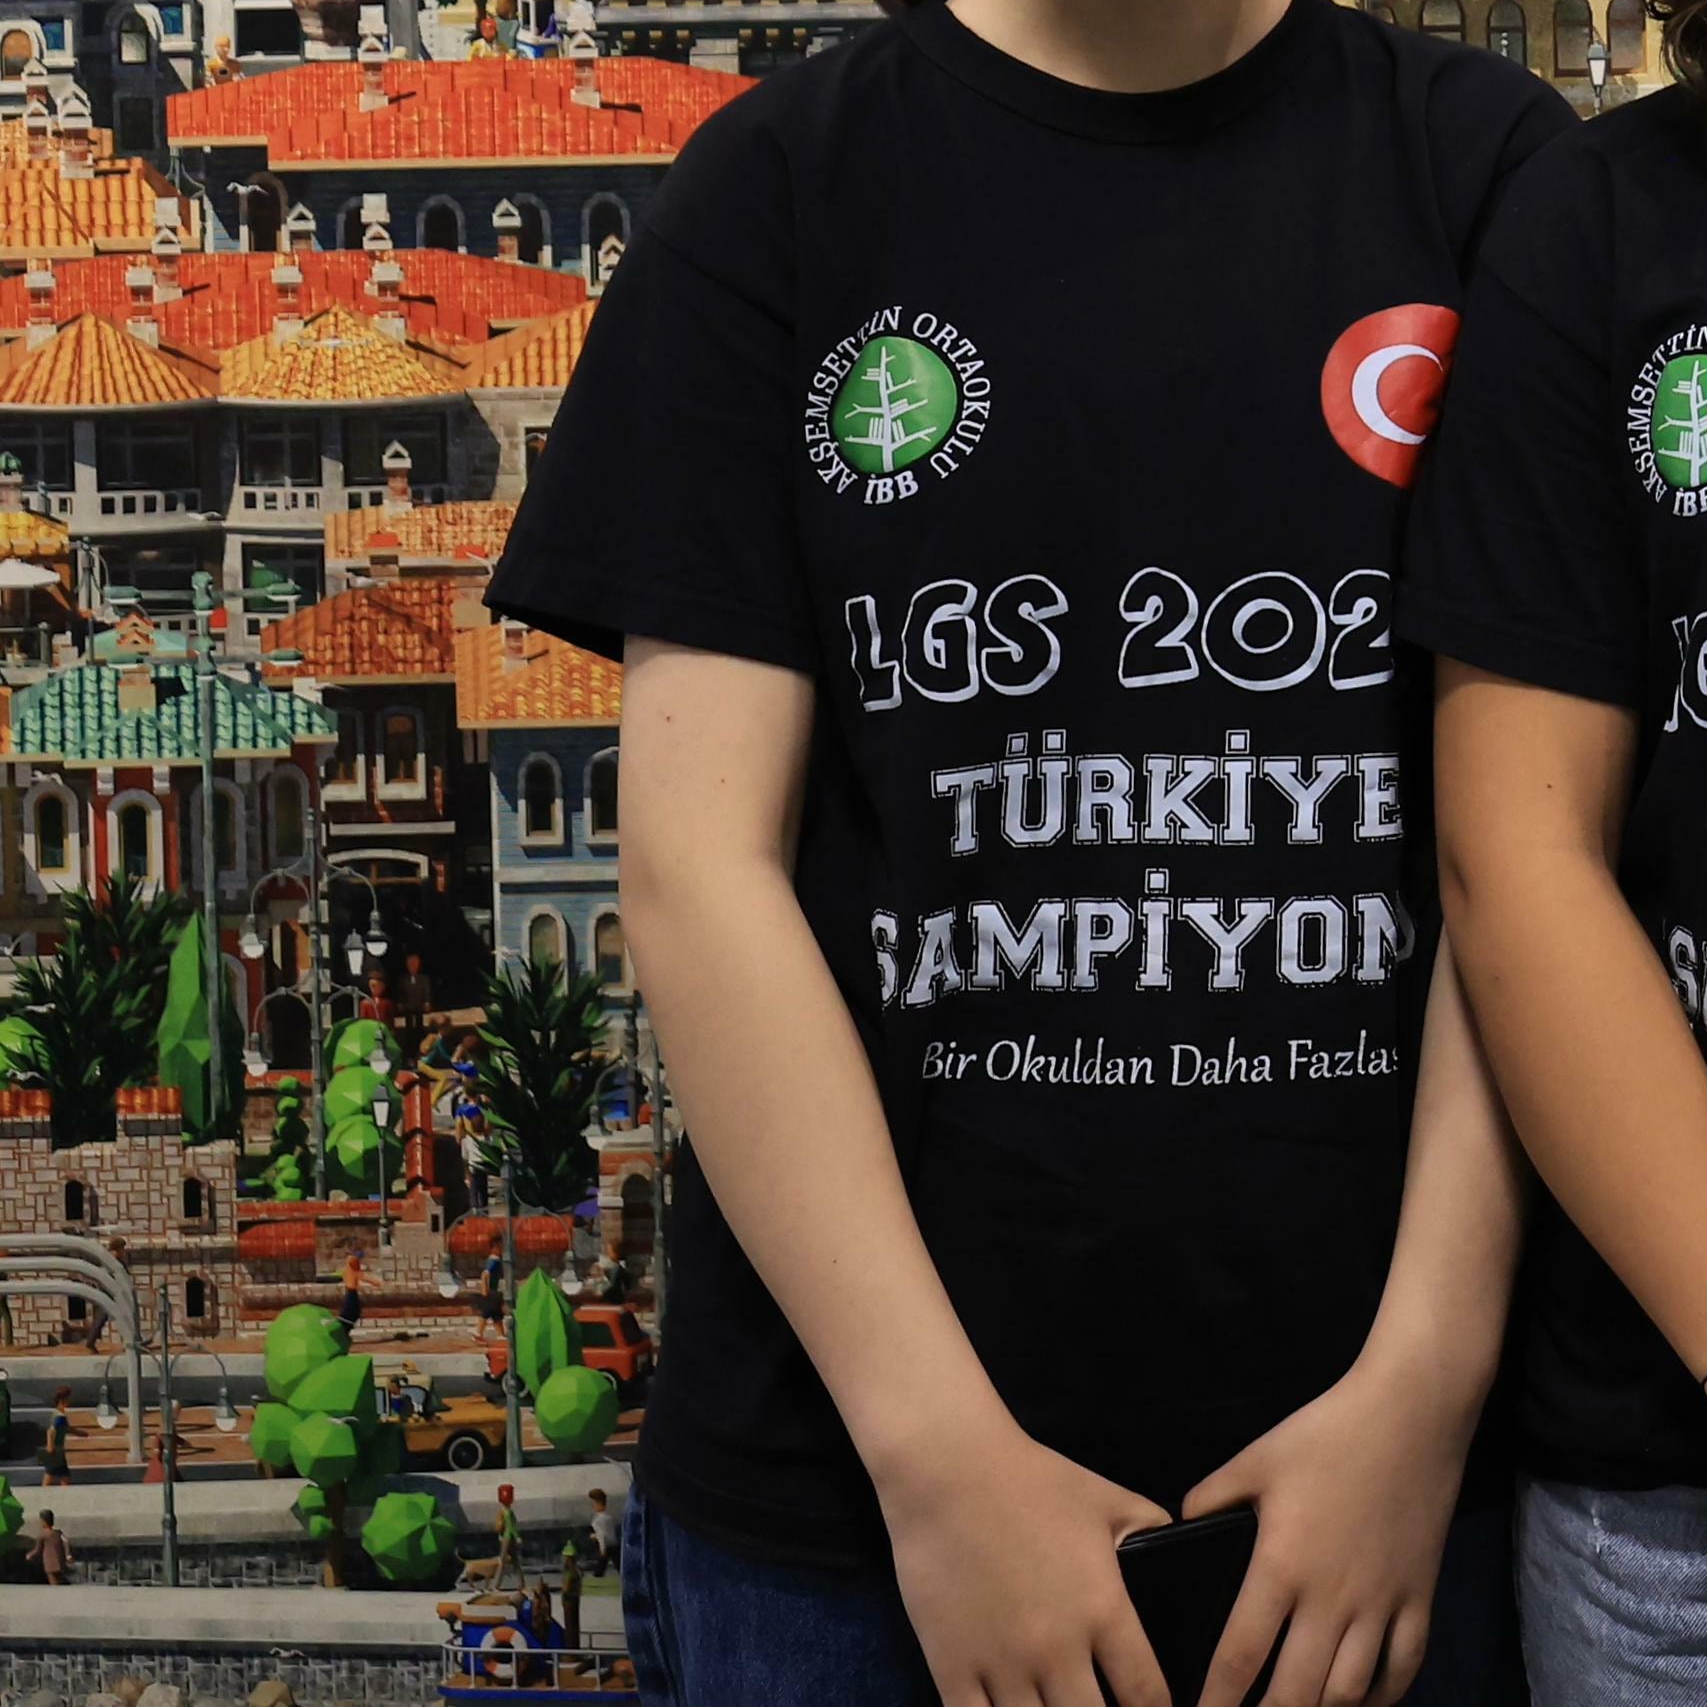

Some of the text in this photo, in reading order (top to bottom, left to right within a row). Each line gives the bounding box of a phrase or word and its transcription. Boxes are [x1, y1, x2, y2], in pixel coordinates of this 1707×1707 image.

[912, 312, 992, 479] ORTAOKULU
[864, 473, 919, 505] İBB
[845, 566, 1393, 711] LGS 202
[931, 729, 1402, 856] TÜRKİYE
[987, 1035, 1155, 1084] Okuldan
[1170, 1037, 1272, 1086] Daha
